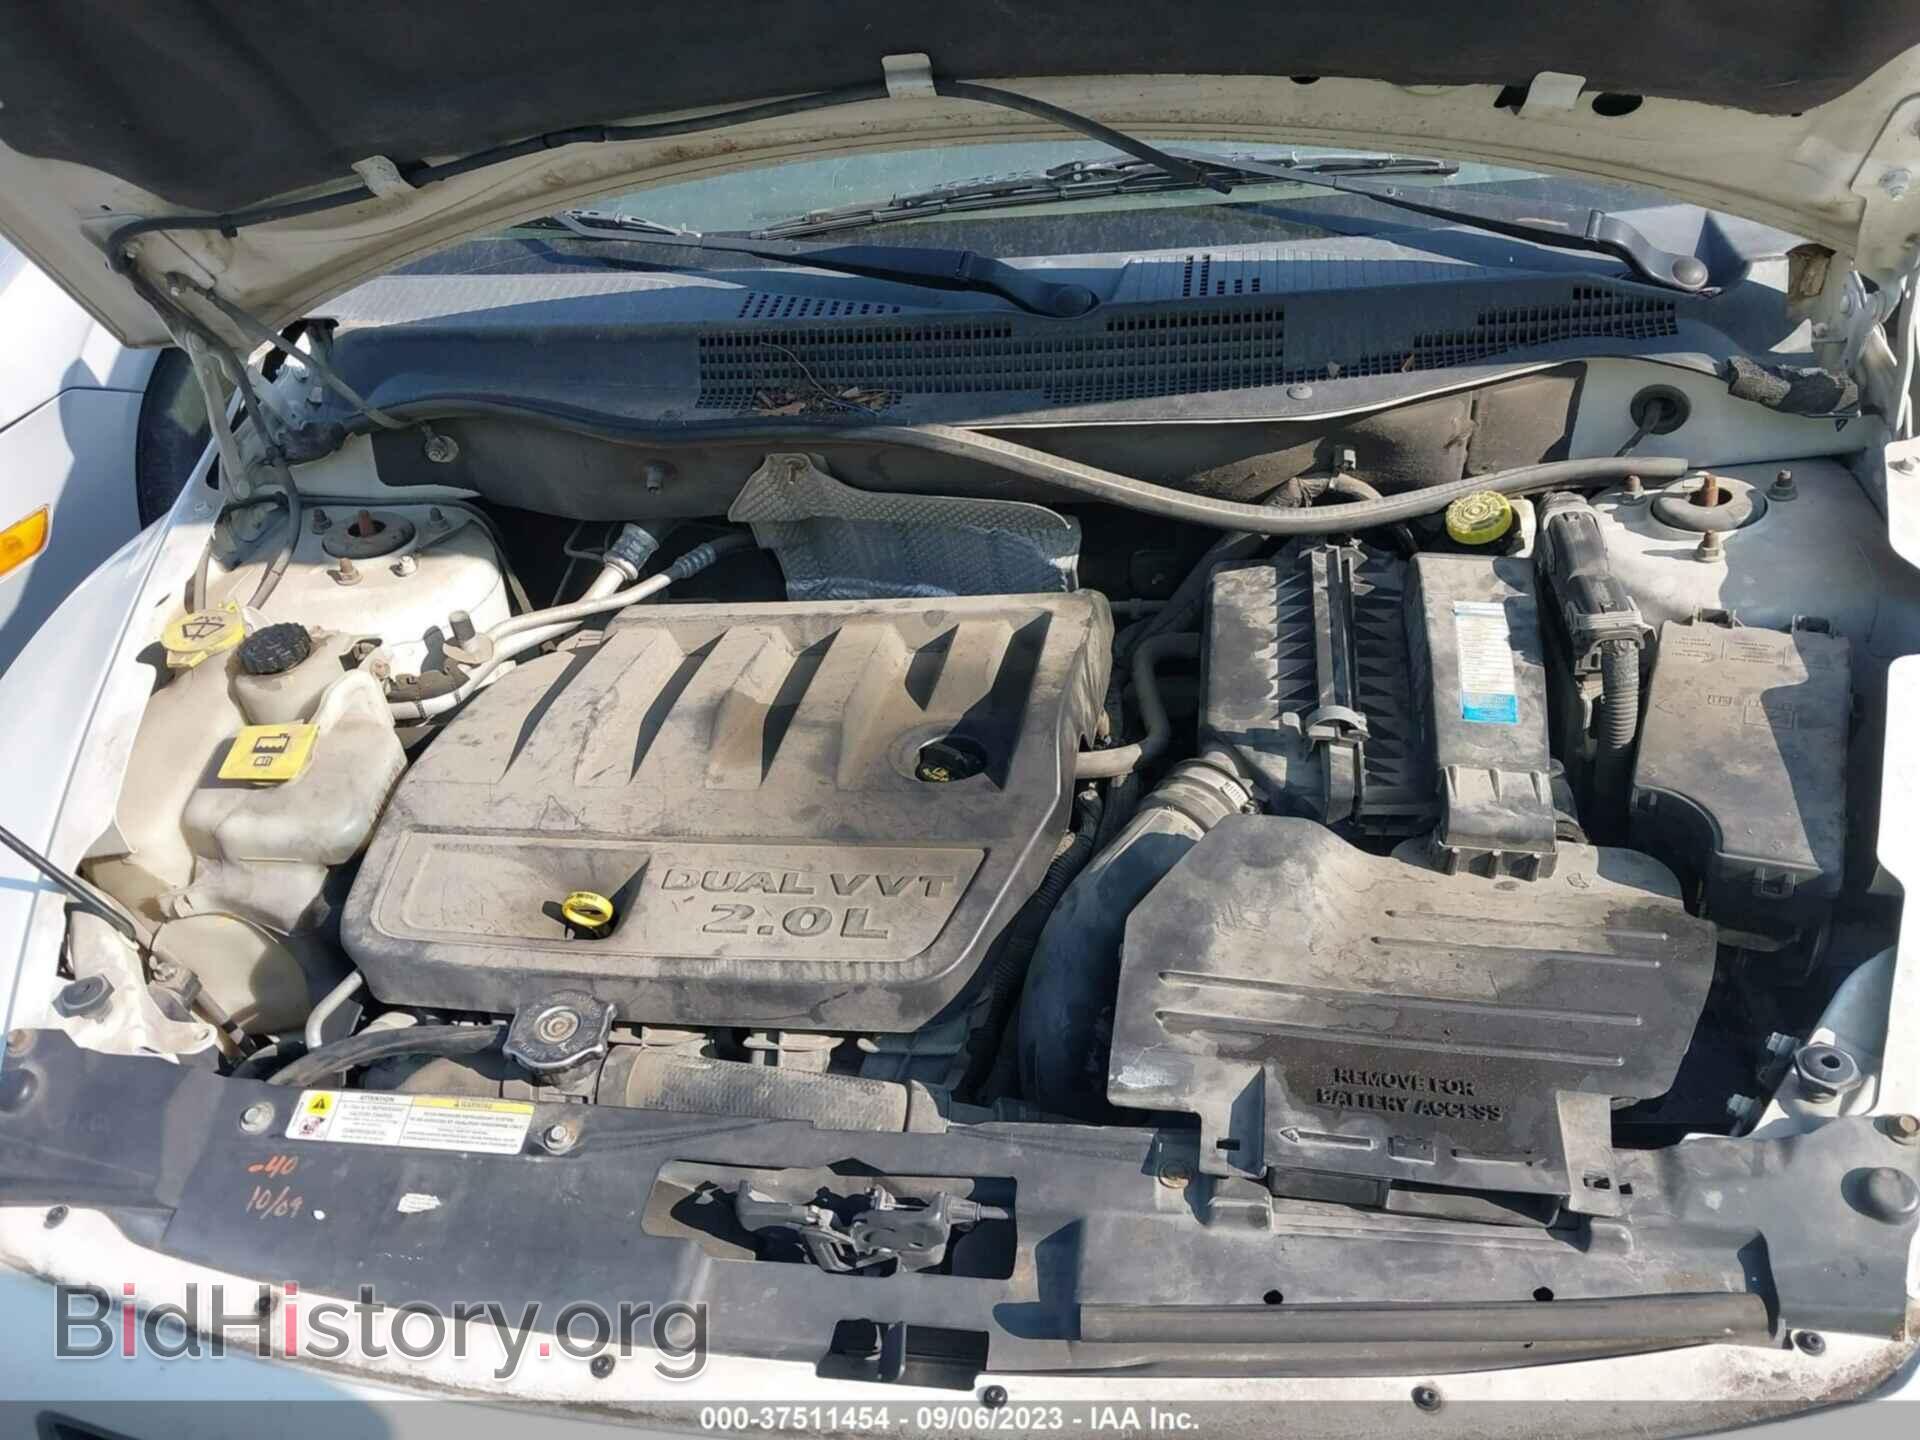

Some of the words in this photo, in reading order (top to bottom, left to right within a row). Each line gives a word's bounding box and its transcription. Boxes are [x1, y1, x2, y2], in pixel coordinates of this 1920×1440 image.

[661, 868, 815, 895] DUAL
[830, 873, 954, 898] VVT
[702, 903, 888, 939] 2.0L
[1333, 1068, 1425, 1092] REMOVE
[1429, 1077, 1476, 1097] FOR
[1316, 1088, 1410, 1113] BATTERY
[1413, 1101, 1503, 1122] ACCESS
